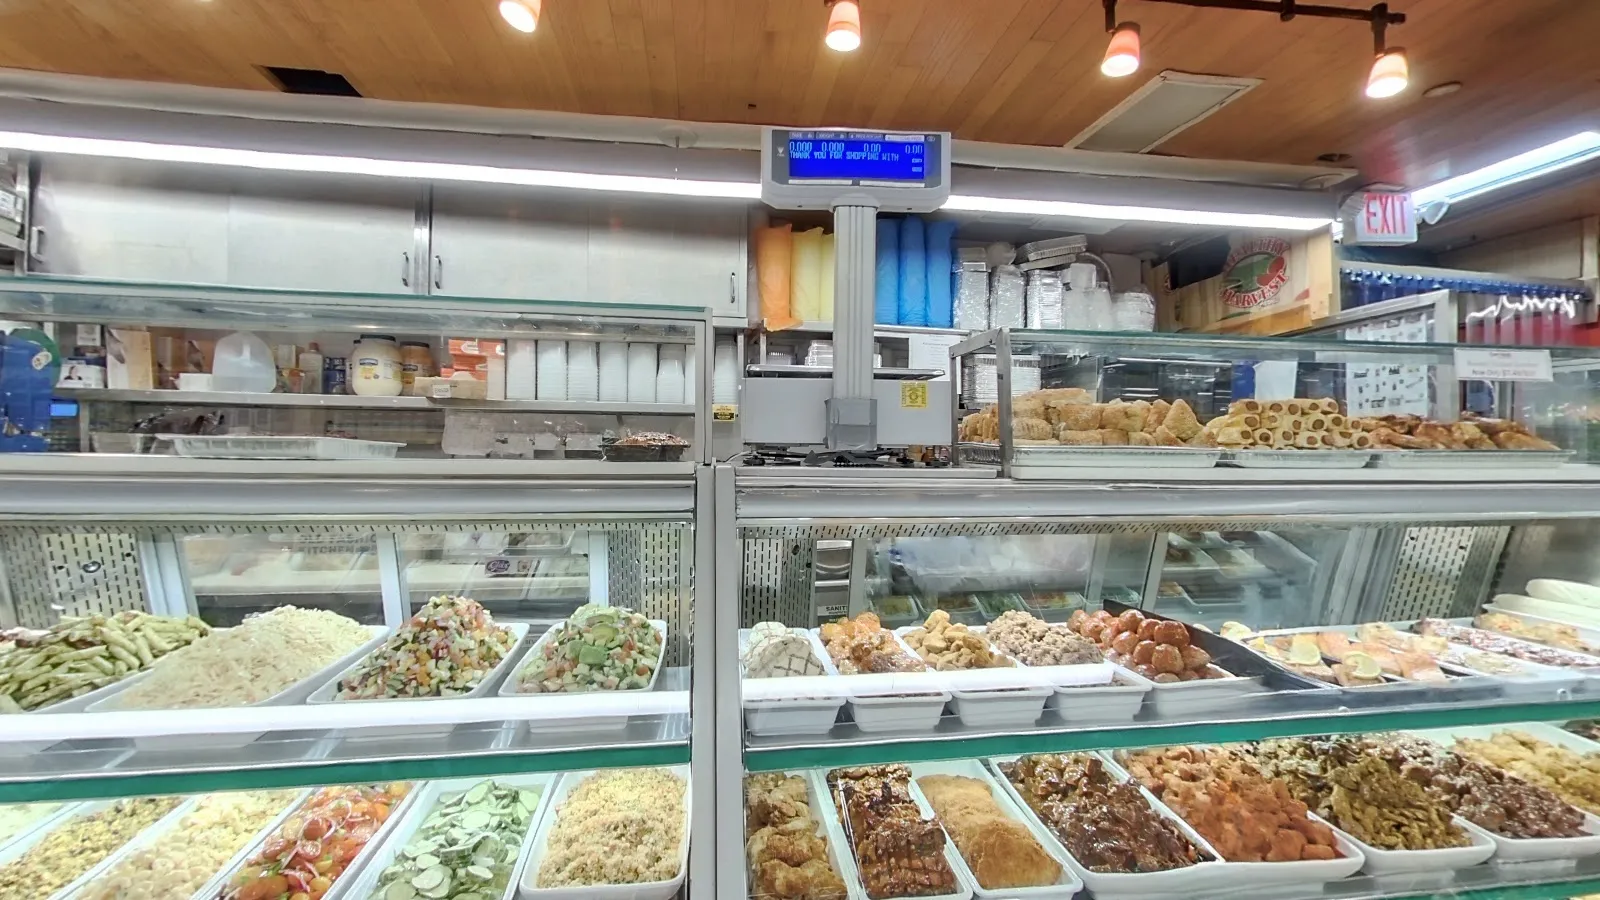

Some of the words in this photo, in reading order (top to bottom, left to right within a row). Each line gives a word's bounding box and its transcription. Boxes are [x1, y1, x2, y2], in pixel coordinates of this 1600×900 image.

[789, 141, 813, 152] 0.000
[821, 141, 845, 152] 0.000
[863, 142, 882, 153] 0.00
[904, 144, 923, 154] 0.00
[790, 151, 811, 159] THANK
[813, 151, 827, 159] YOU
[829, 151, 843, 159] FOR
[846, 151, 879, 160] SHOPPING
[882, 153, 899, 162] WITH
[1365, 193, 1408, 234] EXIT
[1219, 270, 1290, 308] HARVEST
